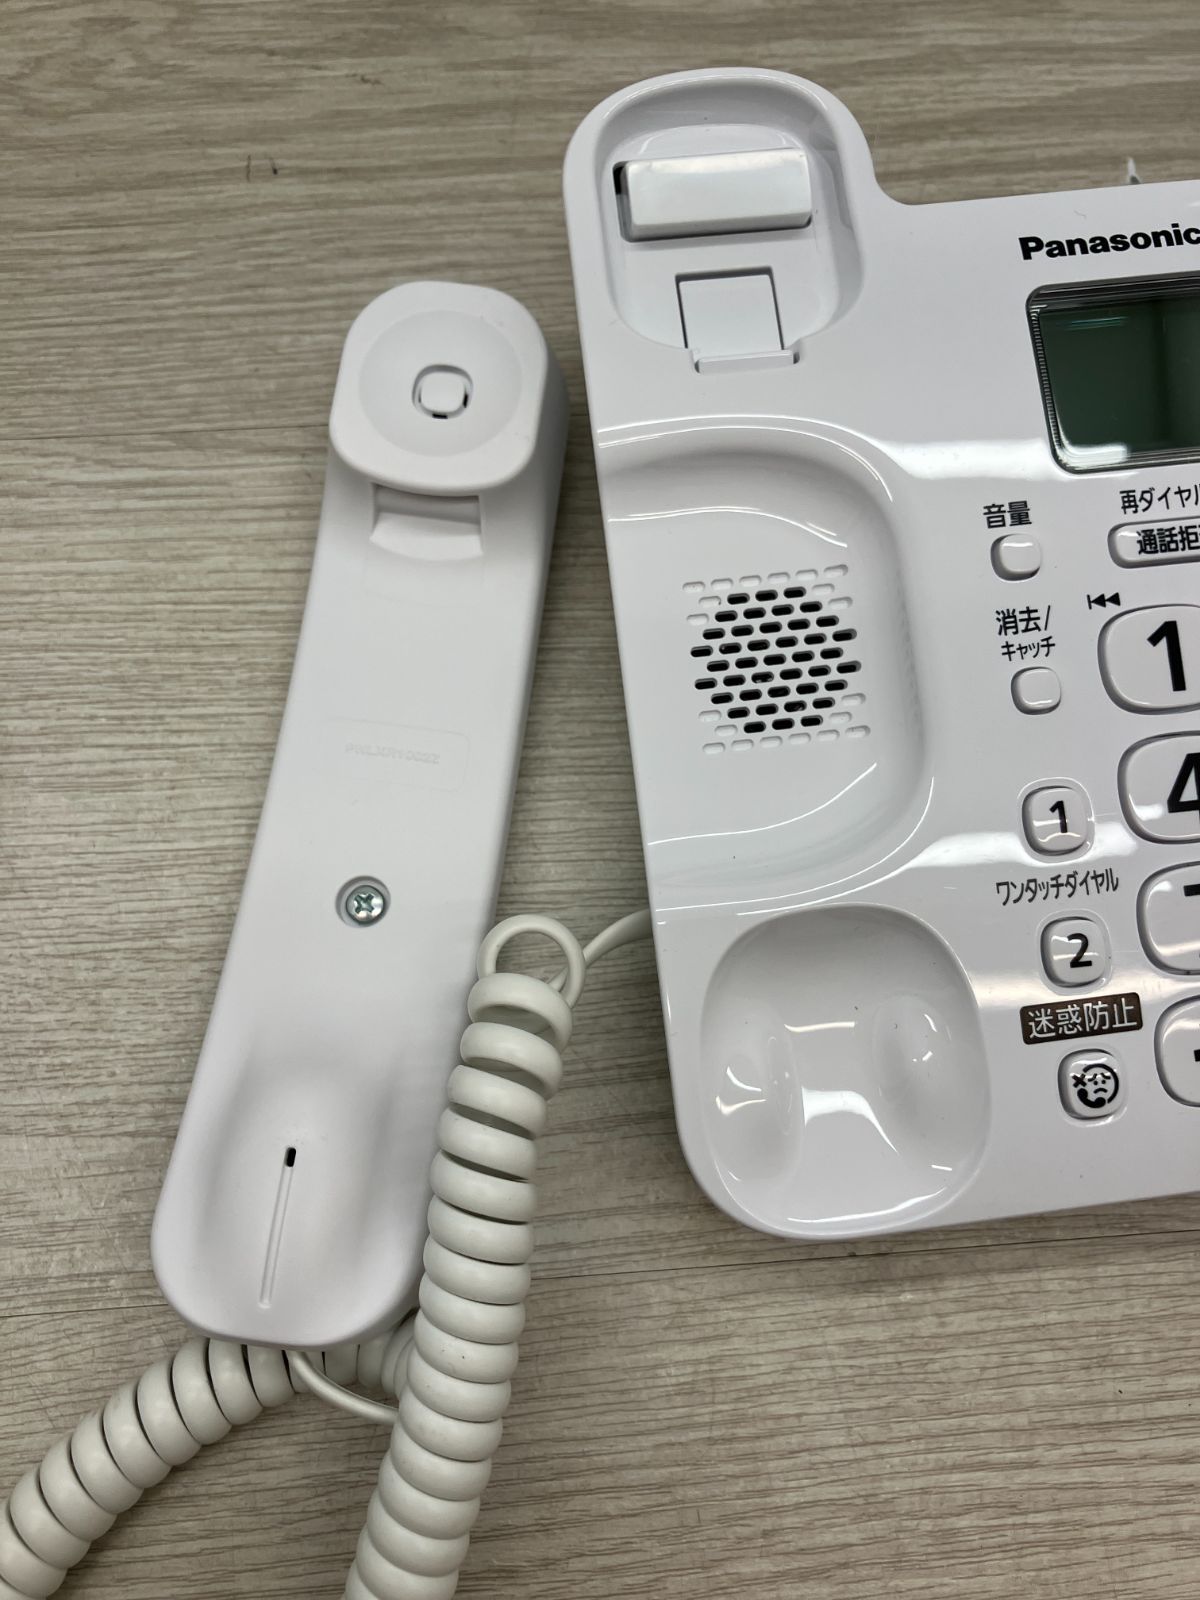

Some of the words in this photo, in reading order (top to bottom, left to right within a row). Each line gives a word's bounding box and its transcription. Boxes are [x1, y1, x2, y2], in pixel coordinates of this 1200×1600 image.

[1018, 223, 1200, 260] Panasonic
[983, 500, 1033, 529] 音量
[1136, 524, 1200, 555] 通話拒
[995, 604, 1051, 636] 消去/
[1001, 636, 1056, 662] キャッチ
[1147, 620, 1187, 692] 1
[1167, 752, 1200, 824] 4
[1049, 800, 1068, 833] 1
[996, 867, 1119, 906] ワンタッチダイヤル
[1067, 932, 1093, 968] 2
[1028, 998, 1138, 1039] 迷惑防止
